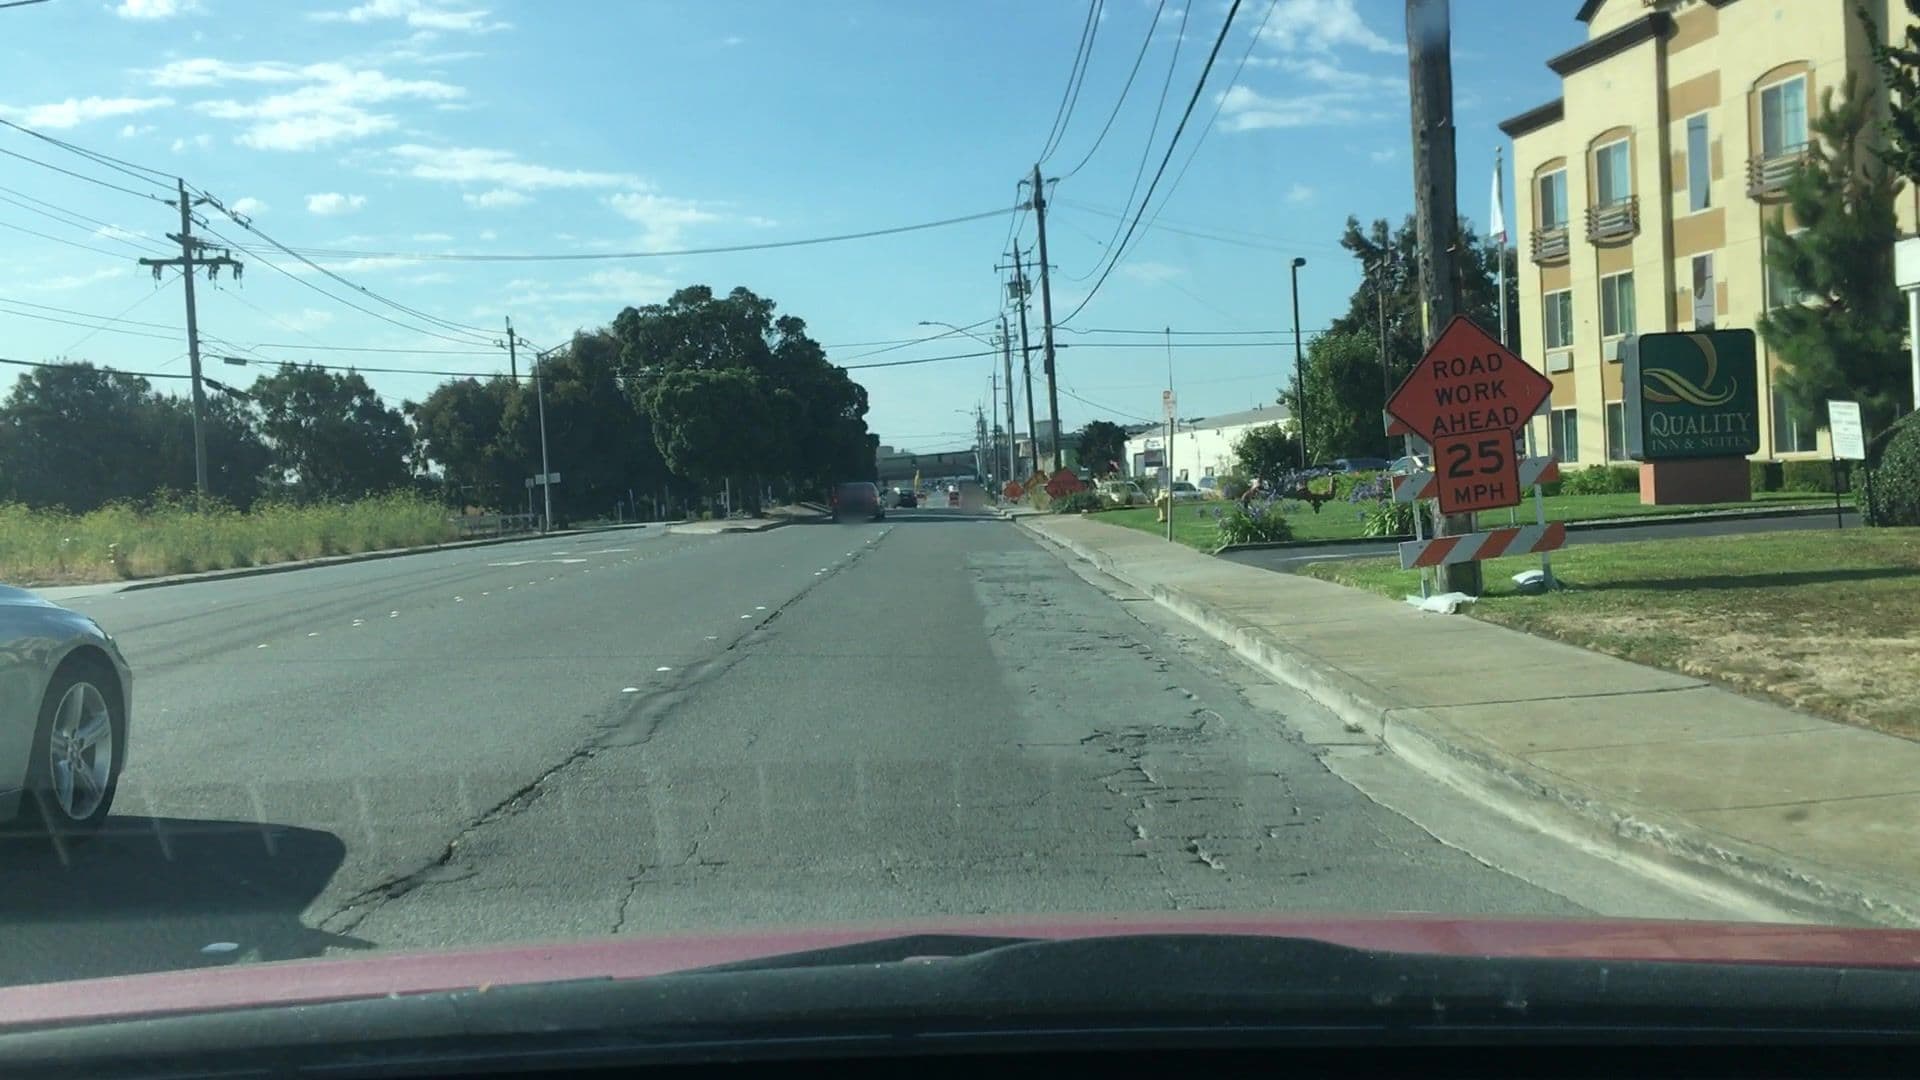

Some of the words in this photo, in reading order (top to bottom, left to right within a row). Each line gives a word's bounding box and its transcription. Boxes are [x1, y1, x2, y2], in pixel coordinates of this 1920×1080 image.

[1432, 353, 1503, 379] ROAD
[1435, 380, 1507, 406] WORK
[1432, 407, 1518, 435] AHEAD
[1650, 411, 1751, 437] QUALITY
[1652, 438, 1680, 451] INN
[1684, 438, 1695, 449] &
[1447, 440, 1504, 478] 25
[1455, 482, 1504, 505] MPH
